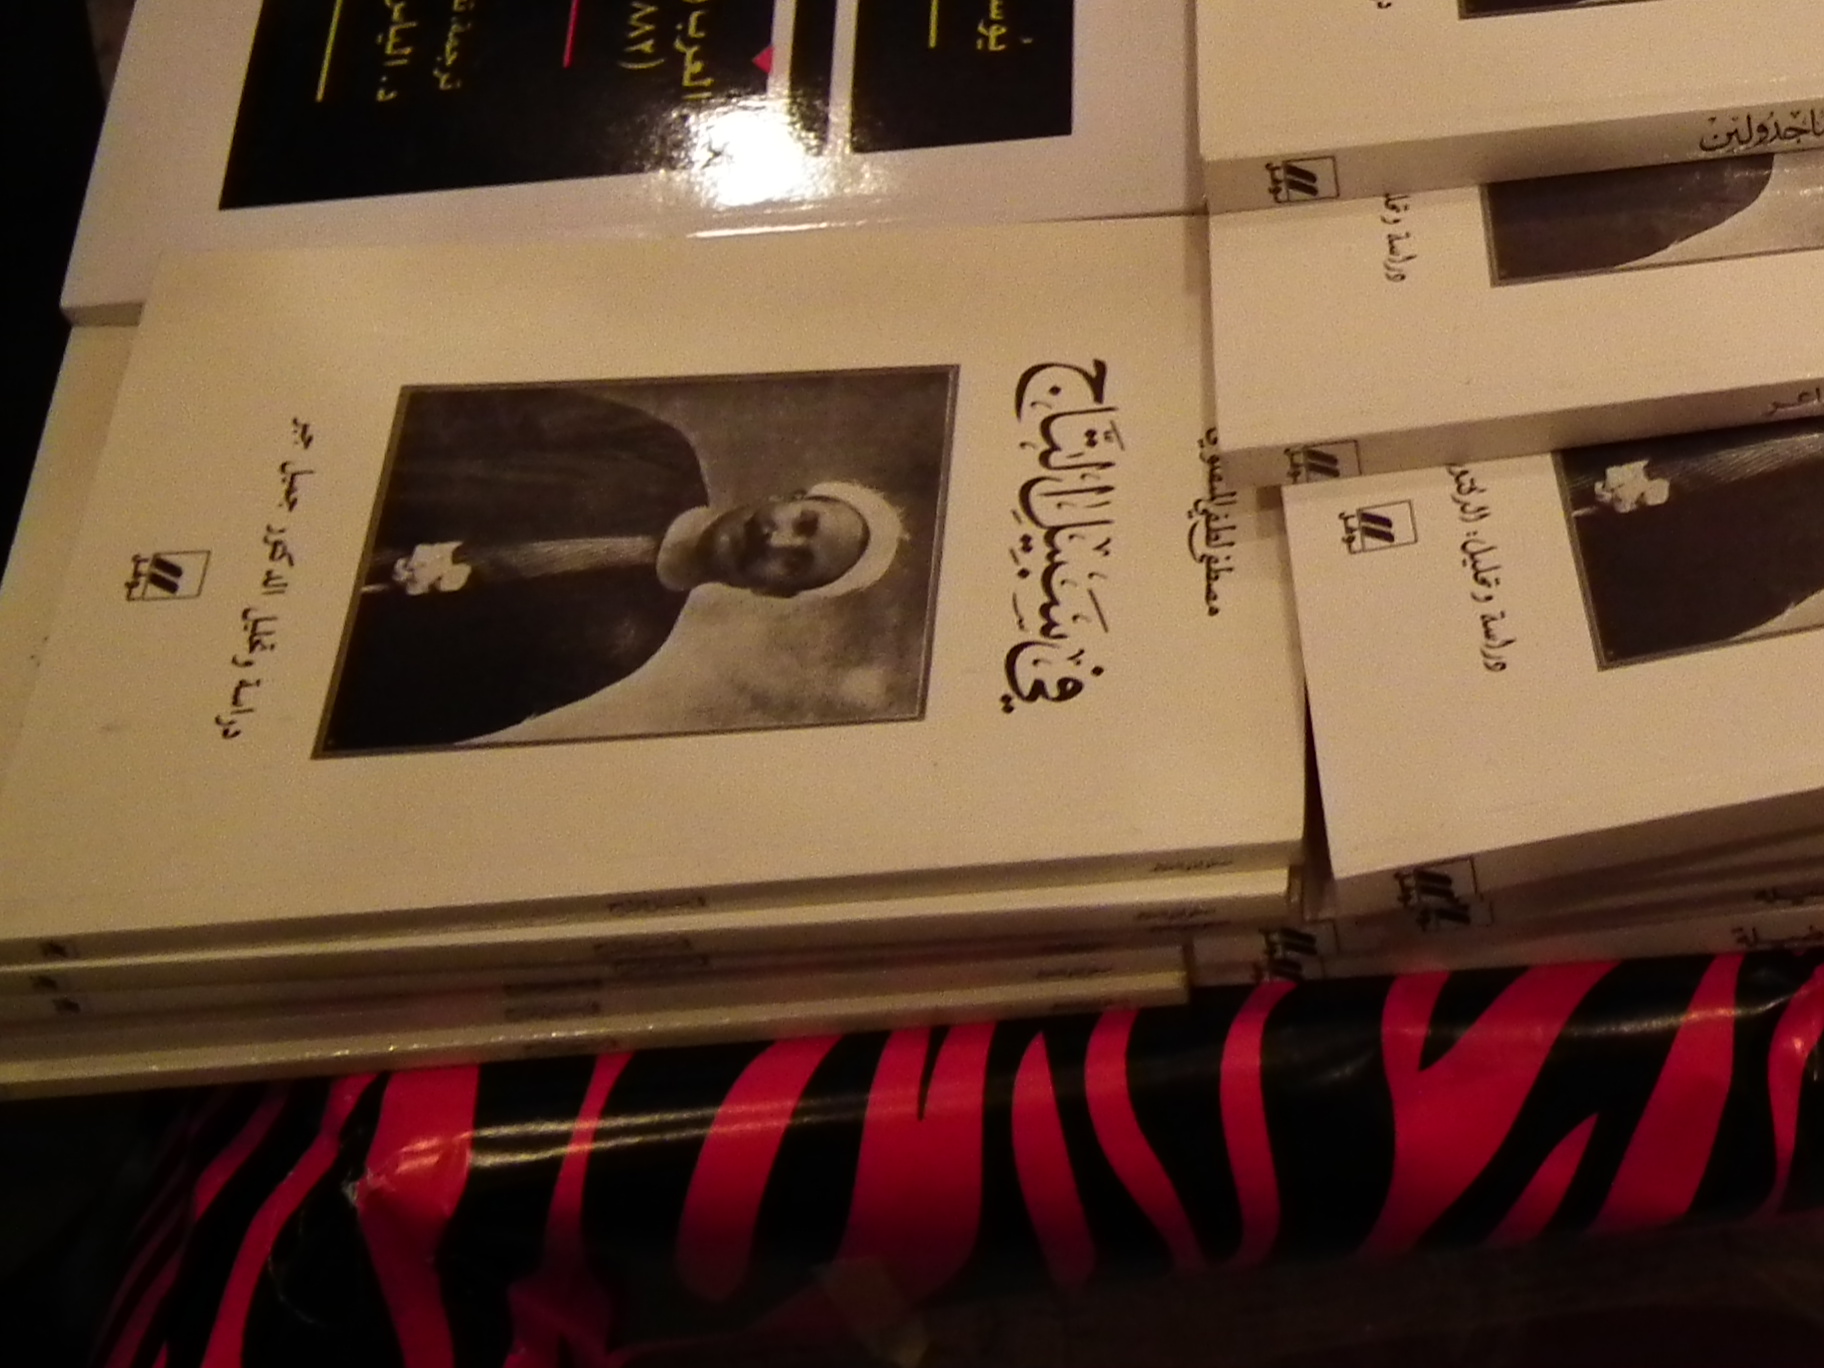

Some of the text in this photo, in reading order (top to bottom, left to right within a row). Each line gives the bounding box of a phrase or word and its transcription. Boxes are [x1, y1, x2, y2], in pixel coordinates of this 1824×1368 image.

[673, 10, 717, 102] العرب
[215, 417, 316, 740] دراسة وتحليل الدكتور جميل جبر
[1000, 358, 1127, 715] في سبيل التاج
[1188, 521, 1234, 618] مصطفى
[1479, 609, 1521, 673] دراسة
